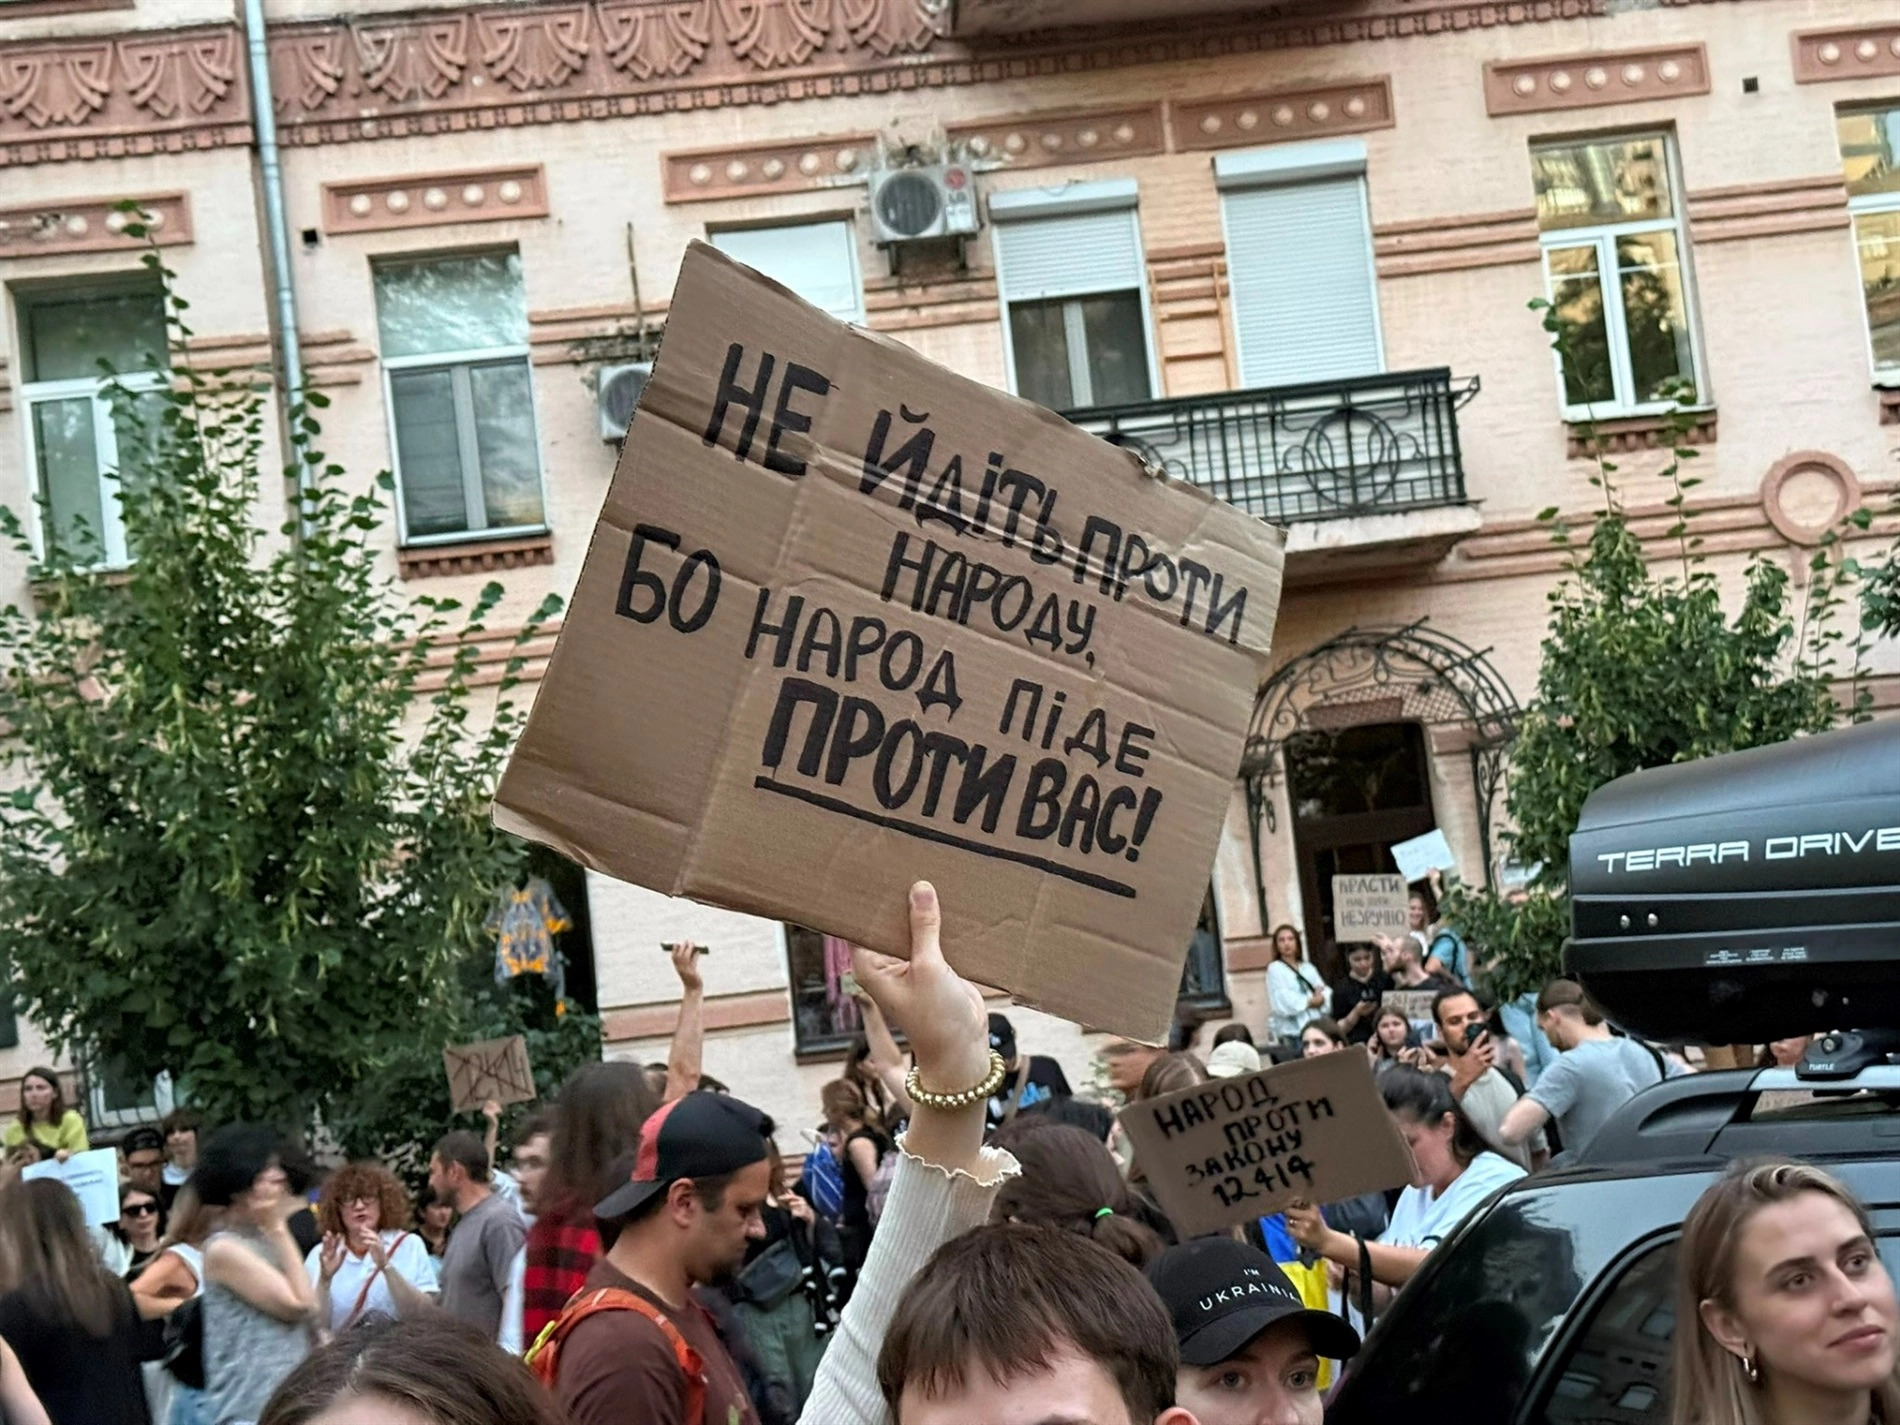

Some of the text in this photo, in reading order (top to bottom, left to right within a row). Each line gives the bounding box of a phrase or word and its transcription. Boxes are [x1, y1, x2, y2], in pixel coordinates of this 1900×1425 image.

[701, 343, 832, 477] НЕ
[1072, 515, 1248, 645] ПРОТИ
[614, 522, 721, 633] БО
[745, 588, 963, 722] НАРОД
[880, 531, 1097, 669] НАРОДУ,
[762, 677, 1163, 863] ПРОТИ ВАС!
[1597, 840, 1750, 873] TERRA
[1153, 1076, 1279, 1140] НАРОД
[1223, 1097, 1334, 1146] ПРОТИ
[1185, 1129, 1303, 1187] ЗАКОНУ
[1212, 1155, 1316, 1207] 12414
